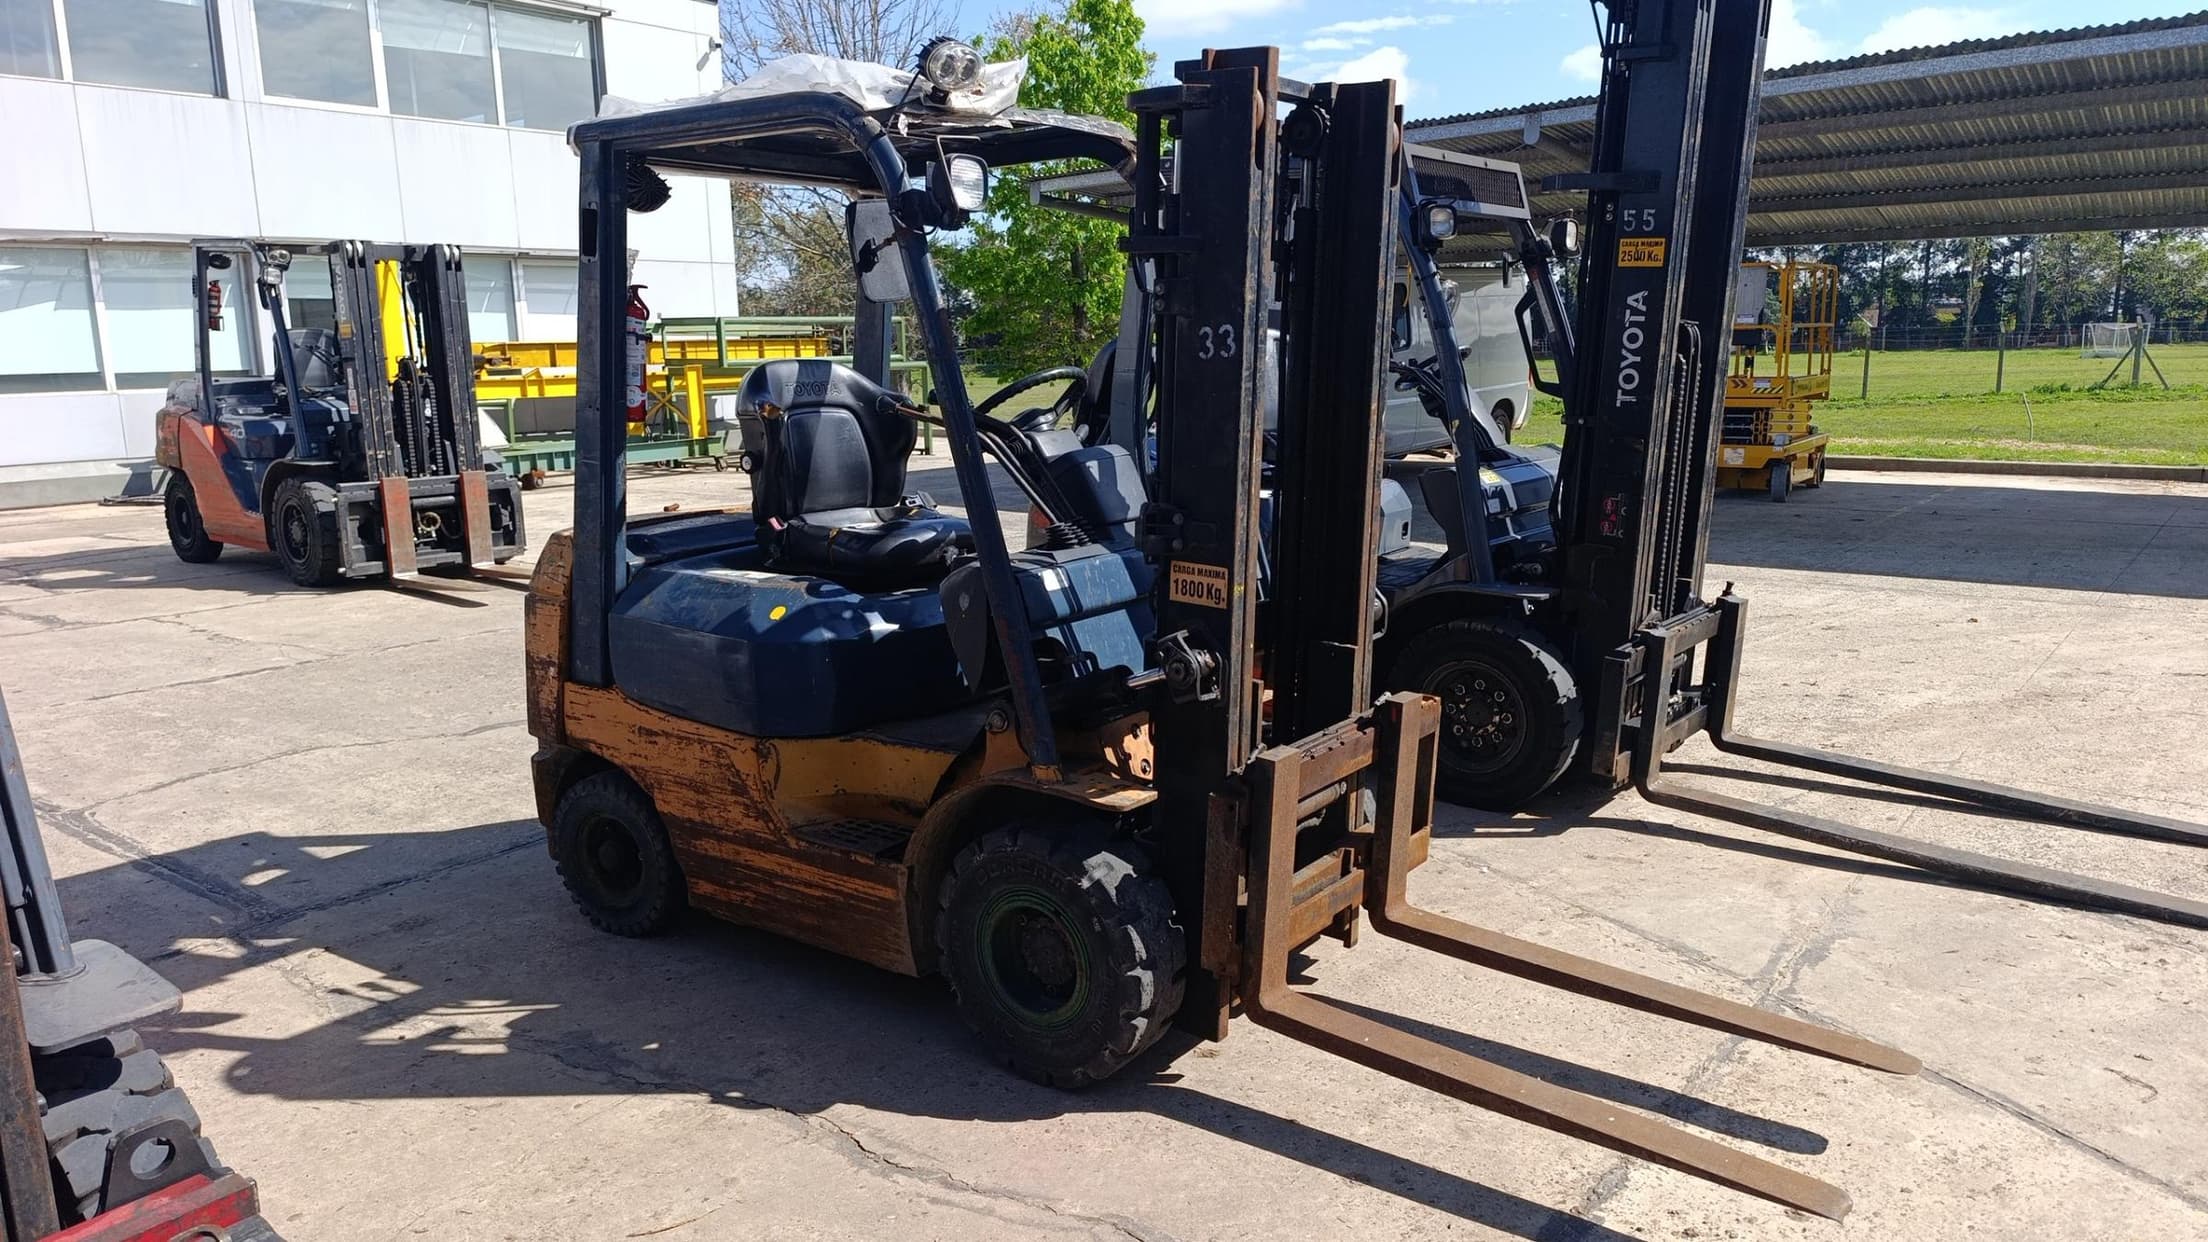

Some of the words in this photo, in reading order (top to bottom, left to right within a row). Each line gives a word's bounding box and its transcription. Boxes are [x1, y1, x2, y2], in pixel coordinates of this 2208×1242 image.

[335, 265, 346, 322] TOYOTA
[1199, 324, 1236, 360] 33
[1616, 290, 1649, 408] TOYOTA
[785, 381, 841, 397] TOYOTA
[1172, 564, 1196, 577] CARGA
[1196, 567, 1227, 580] MAXIMA
[1173, 578, 1204, 599] 1800
[1206, 582, 1226, 606] Kg.
